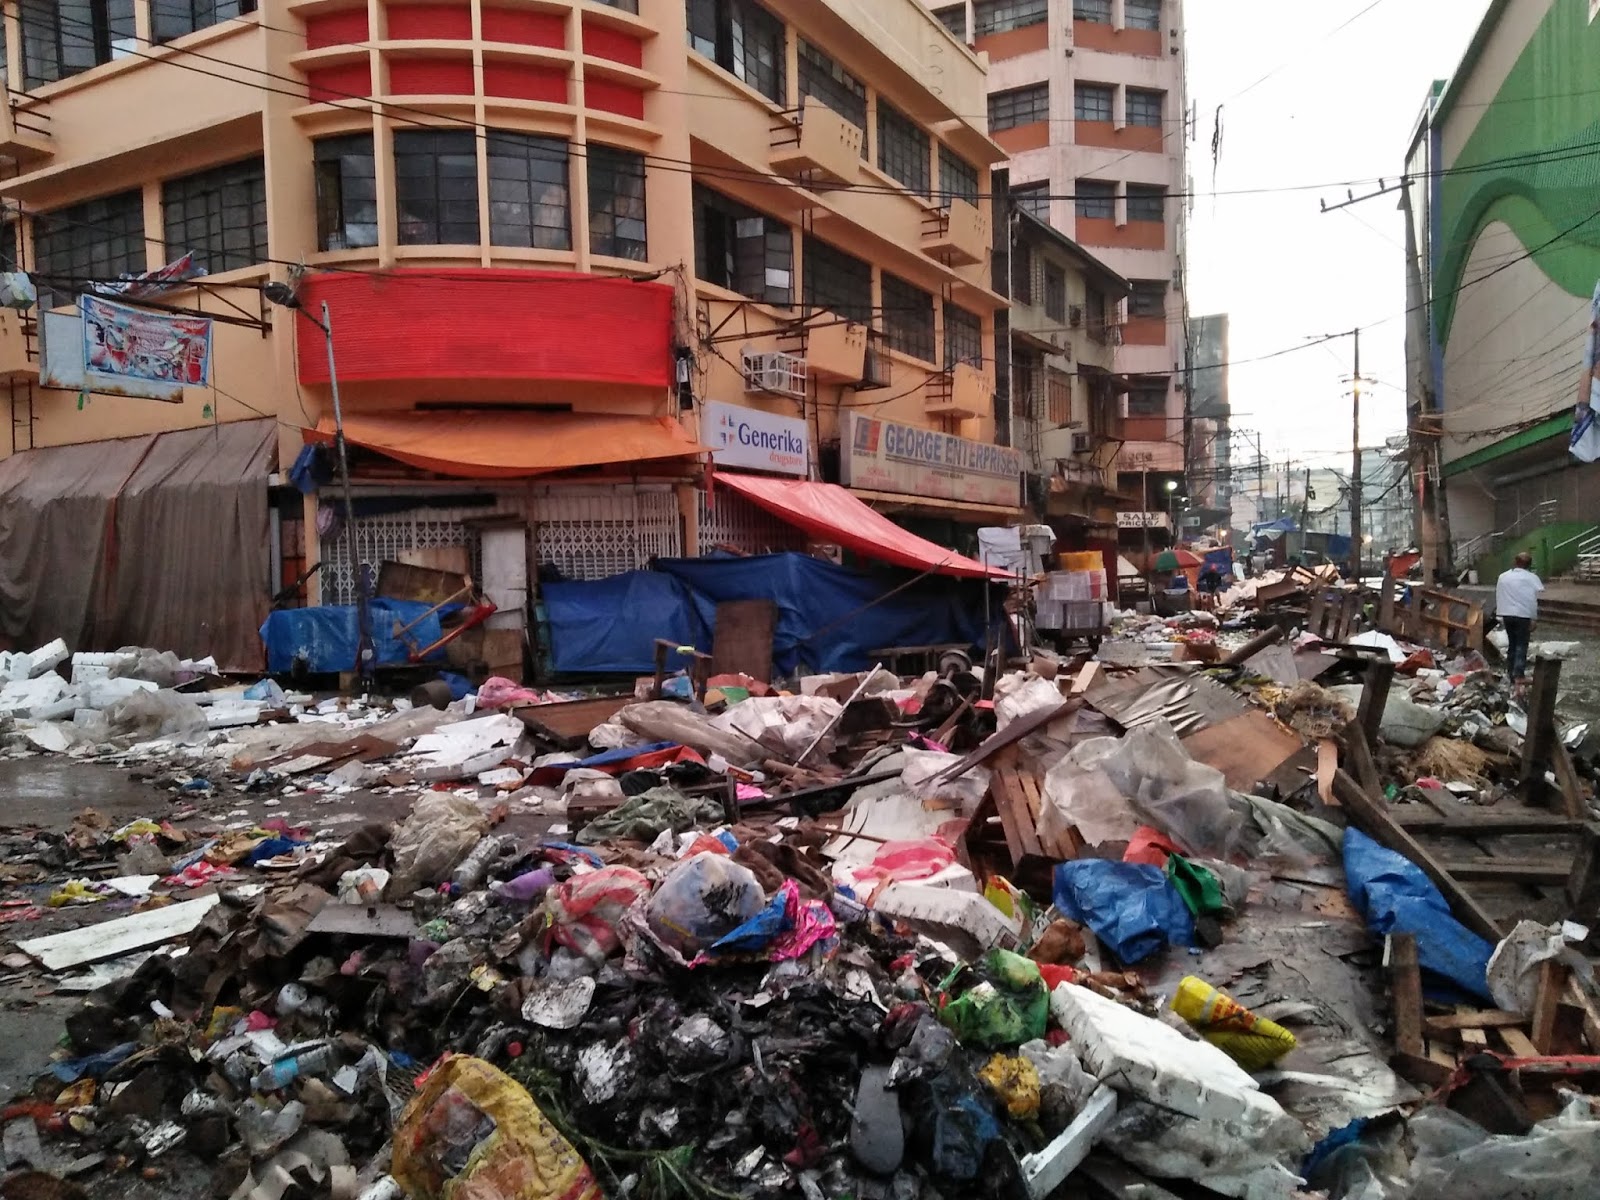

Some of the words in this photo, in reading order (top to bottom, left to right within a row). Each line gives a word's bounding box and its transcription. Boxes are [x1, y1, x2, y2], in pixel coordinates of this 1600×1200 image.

[738, 422, 803, 455] Generika
[885, 423, 942, 461] GEORGE
[945, 437, 1019, 476] ENTERPRISES
[1123, 513, 1160, 521] SALE
